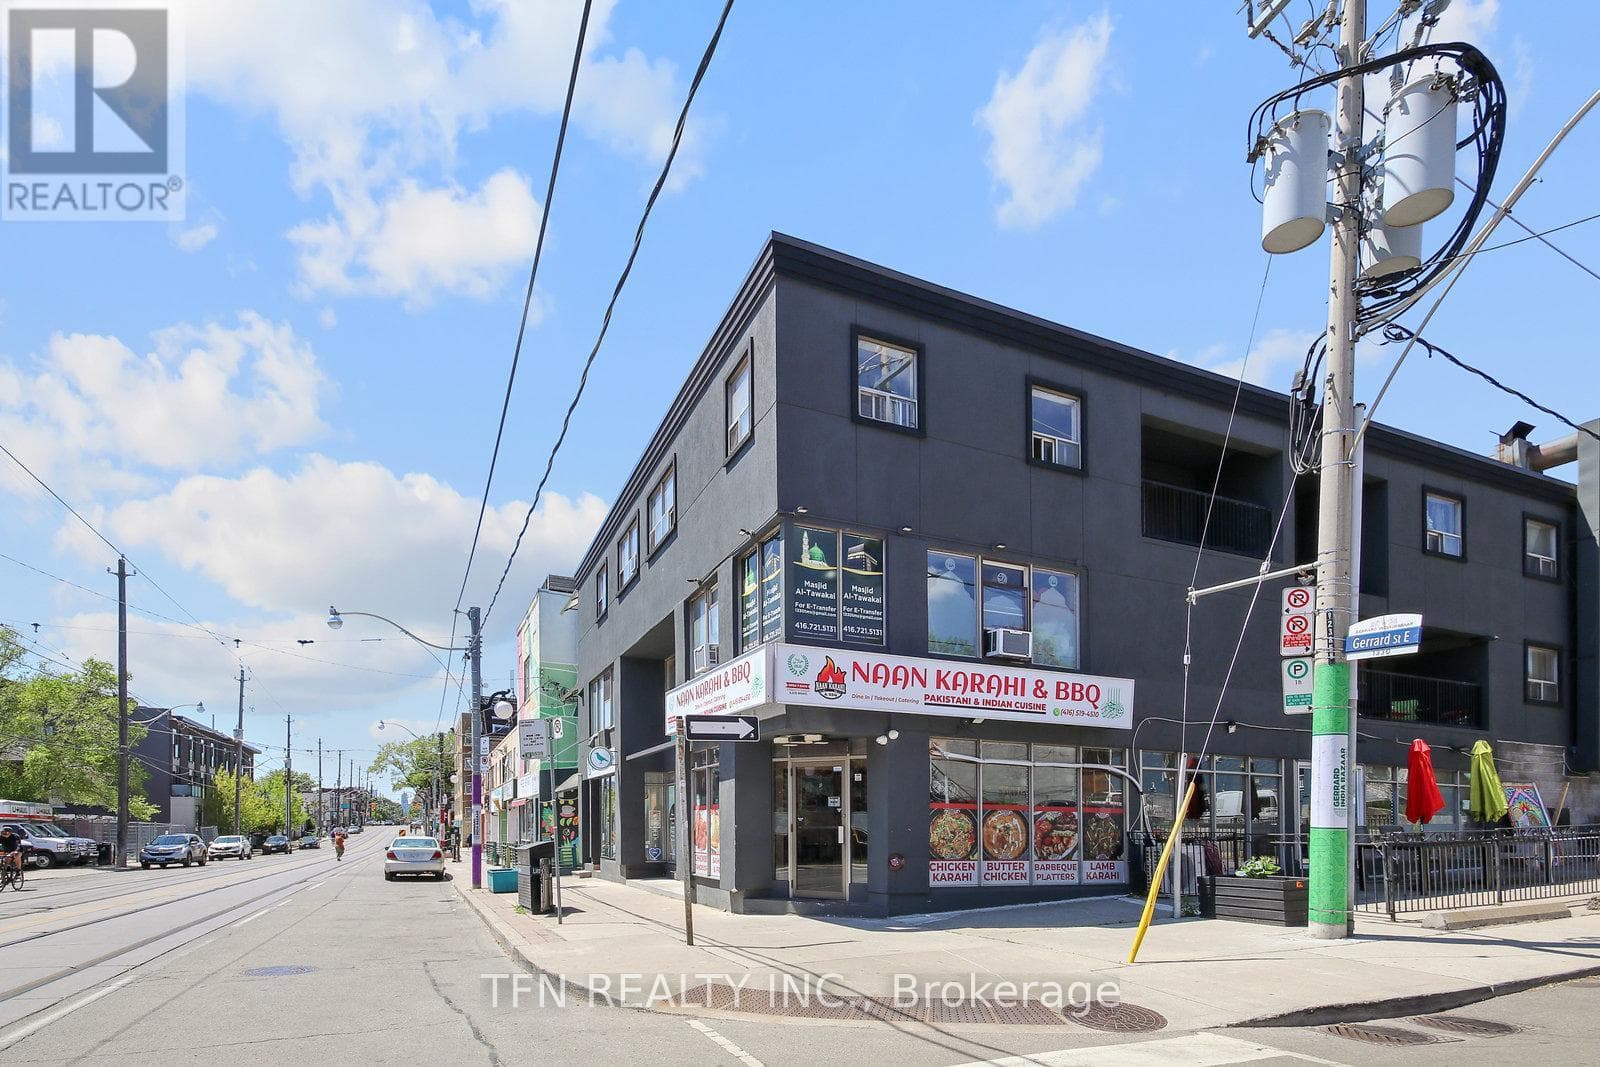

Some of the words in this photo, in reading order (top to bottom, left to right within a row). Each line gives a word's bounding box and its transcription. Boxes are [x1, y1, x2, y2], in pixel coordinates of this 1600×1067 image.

[804, 580, 827, 590] Masjid
[851, 585, 874, 594] Masjid
[795, 588, 836, 599] Al-Tawakal
[843, 592, 882, 604] Al-Tawakal
[807, 603, 837, 612] E-Transfer
[854, 607, 883, 616] E-Transfer
[794, 622, 837, 633] 416.721.5131
[843, 626, 883, 636] 416.721.5131
[1352, 633, 1391, 649] Gerrard
[1393, 634, 1401, 645] St
[1403, 630, 1411, 643] E
[723, 671, 730, 688] &
[731, 661, 751, 684] BBQ
[852, 661, 927, 690] NAAN
[936, 669, 1026, 698] KARAHI
[1032, 679, 1049, 699] &
[1055, 681, 1101, 710] BBQ
[924, 694, 971, 705] PAKISTANI
[982, 699, 1012, 709] INDIAN
[1014, 701, 1046, 711] CUISINE
[929, 862, 976, 871] CHICKEN
[986, 862, 1025, 871] BUTTER
[1034, 863, 1077, 871] BARBEQUE
[1090, 862, 1116, 871] LAMB
[932, 873, 972, 881] KARAHI
[983, 872, 1027, 881] CHICKEN
[1036, 873, 1075, 881] PLATTERS
[1085, 871, 1120, 880] KARAHI
